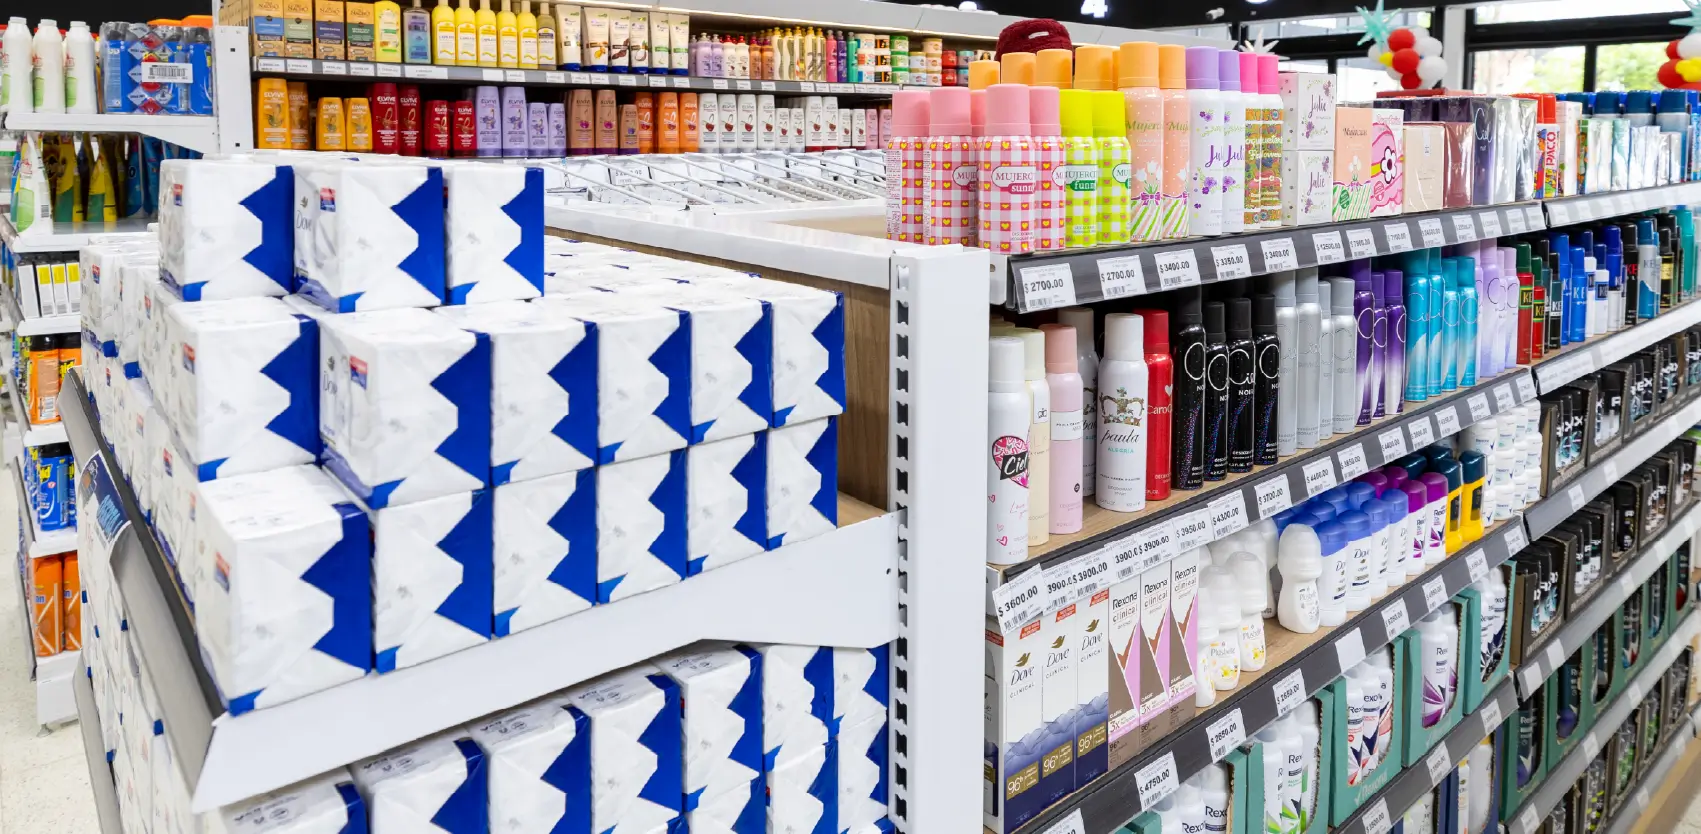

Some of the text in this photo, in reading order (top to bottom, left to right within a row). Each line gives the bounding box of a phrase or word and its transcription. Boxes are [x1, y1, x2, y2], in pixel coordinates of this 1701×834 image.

[1308, 94, 1326, 119] Julie
[1546, 131, 1556, 166] PACO
[1307, 171, 1325, 196] Julie
[1164, 260, 1190, 272] 3400.00
[1220, 255, 1244, 266] 3350.00
[1107, 269, 1135, 281] 2700.00
[1031, 278, 1064, 292] 2700.00
[1100, 429, 1140, 445] paula
[1004, 454, 1028, 476] Ciel
[1263, 487, 1283, 501] 3700.00
[1217, 507, 1239, 522] 4300.00
[1181, 520, 1206, 536] 3950.00
[1144, 535, 1170, 552] 3900.00
[1078, 562, 1108, 582] 3900.00
[1175, 564, 1197, 581] Rexona
[1144, 578, 1168, 595] Rexona
[1004, 585, 1038, 612] 3600.00
[1112, 591, 1138, 610] Rexona
[1144, 590, 1168, 608] clinical
[1112, 604, 1138, 622] clinical
[1081, 632, 1103, 651] Dove
[1046, 648, 1070, 667] Dove
[1080, 648, 1103, 662] CLINICAL
[1011, 666, 1035, 686] Dove
[1045, 665, 1069, 679] CLINICAL
[1009, 683, 1035, 699] CLINICAL
[1110, 719, 1121, 733] 3x
[1215, 722, 1237, 742] 2650.00
[1144, 769, 1170, 790] 4750.00
